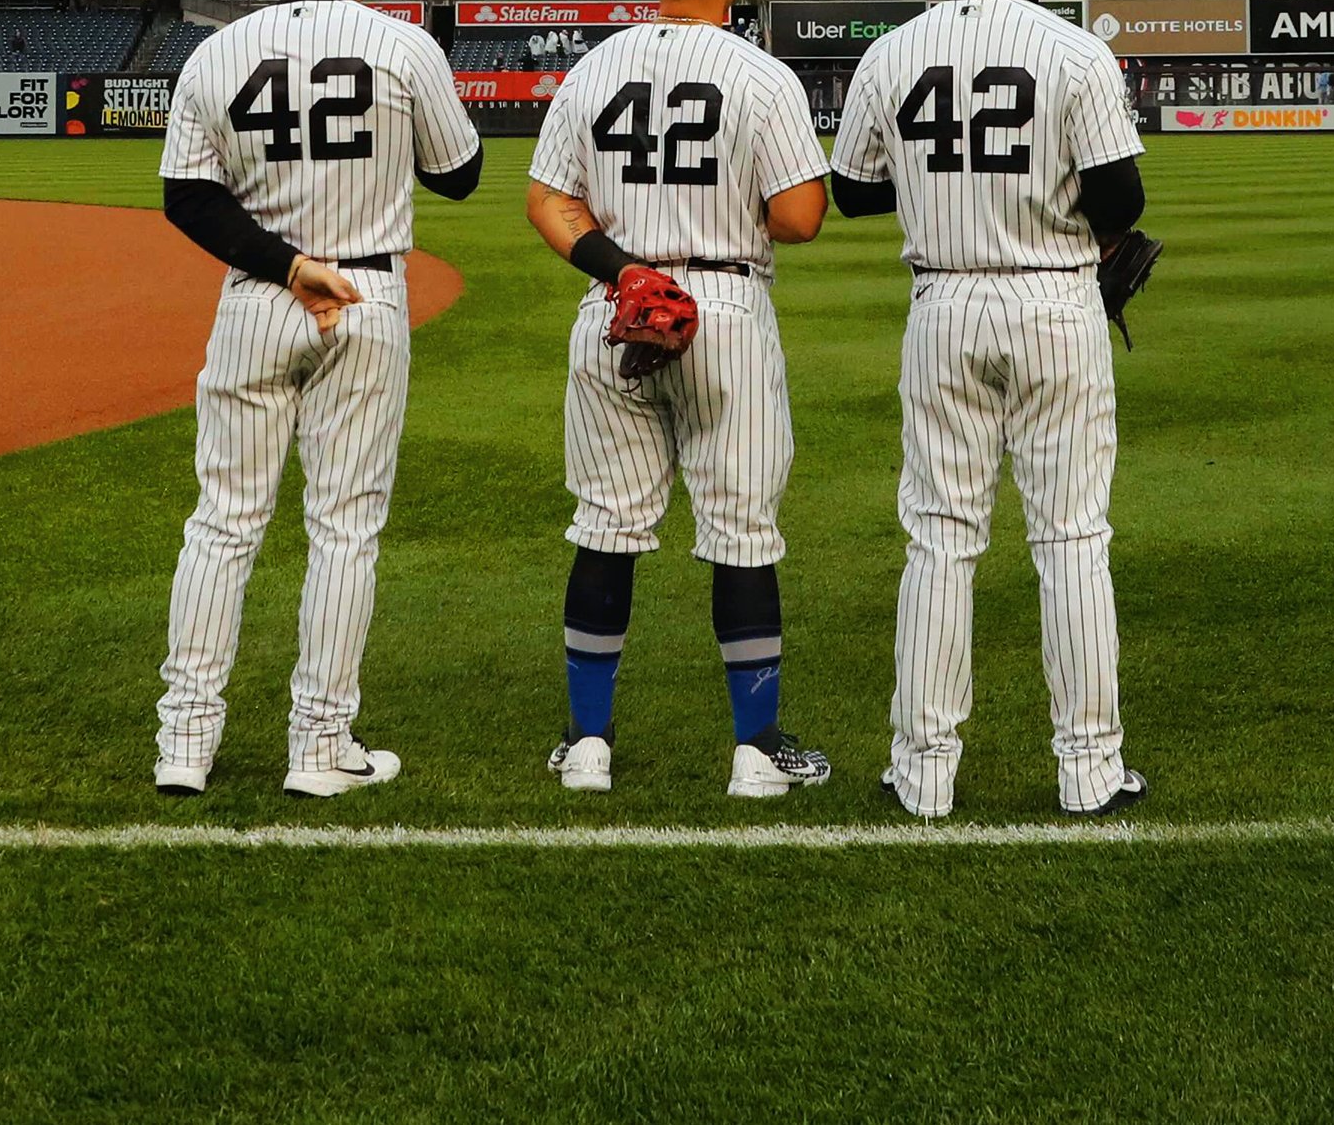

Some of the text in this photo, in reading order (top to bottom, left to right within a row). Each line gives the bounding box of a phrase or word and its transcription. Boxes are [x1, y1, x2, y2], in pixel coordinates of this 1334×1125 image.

[797, 21, 846, 39] Uber
[1126, 20, 1243, 33] LOTTE HOTELS
[20, 79, 49, 91] FIT
[104, 79, 169, 88] BUD LIGHT
[9, 92, 48, 105] FOR
[103, 89, 170, 111] SELTZER
[228, 58, 373, 162] 42
[102, 111, 169, 126] LEMONADE
[895, 65, 1036, 174] 42
[592, 80, 724, 185] 42
